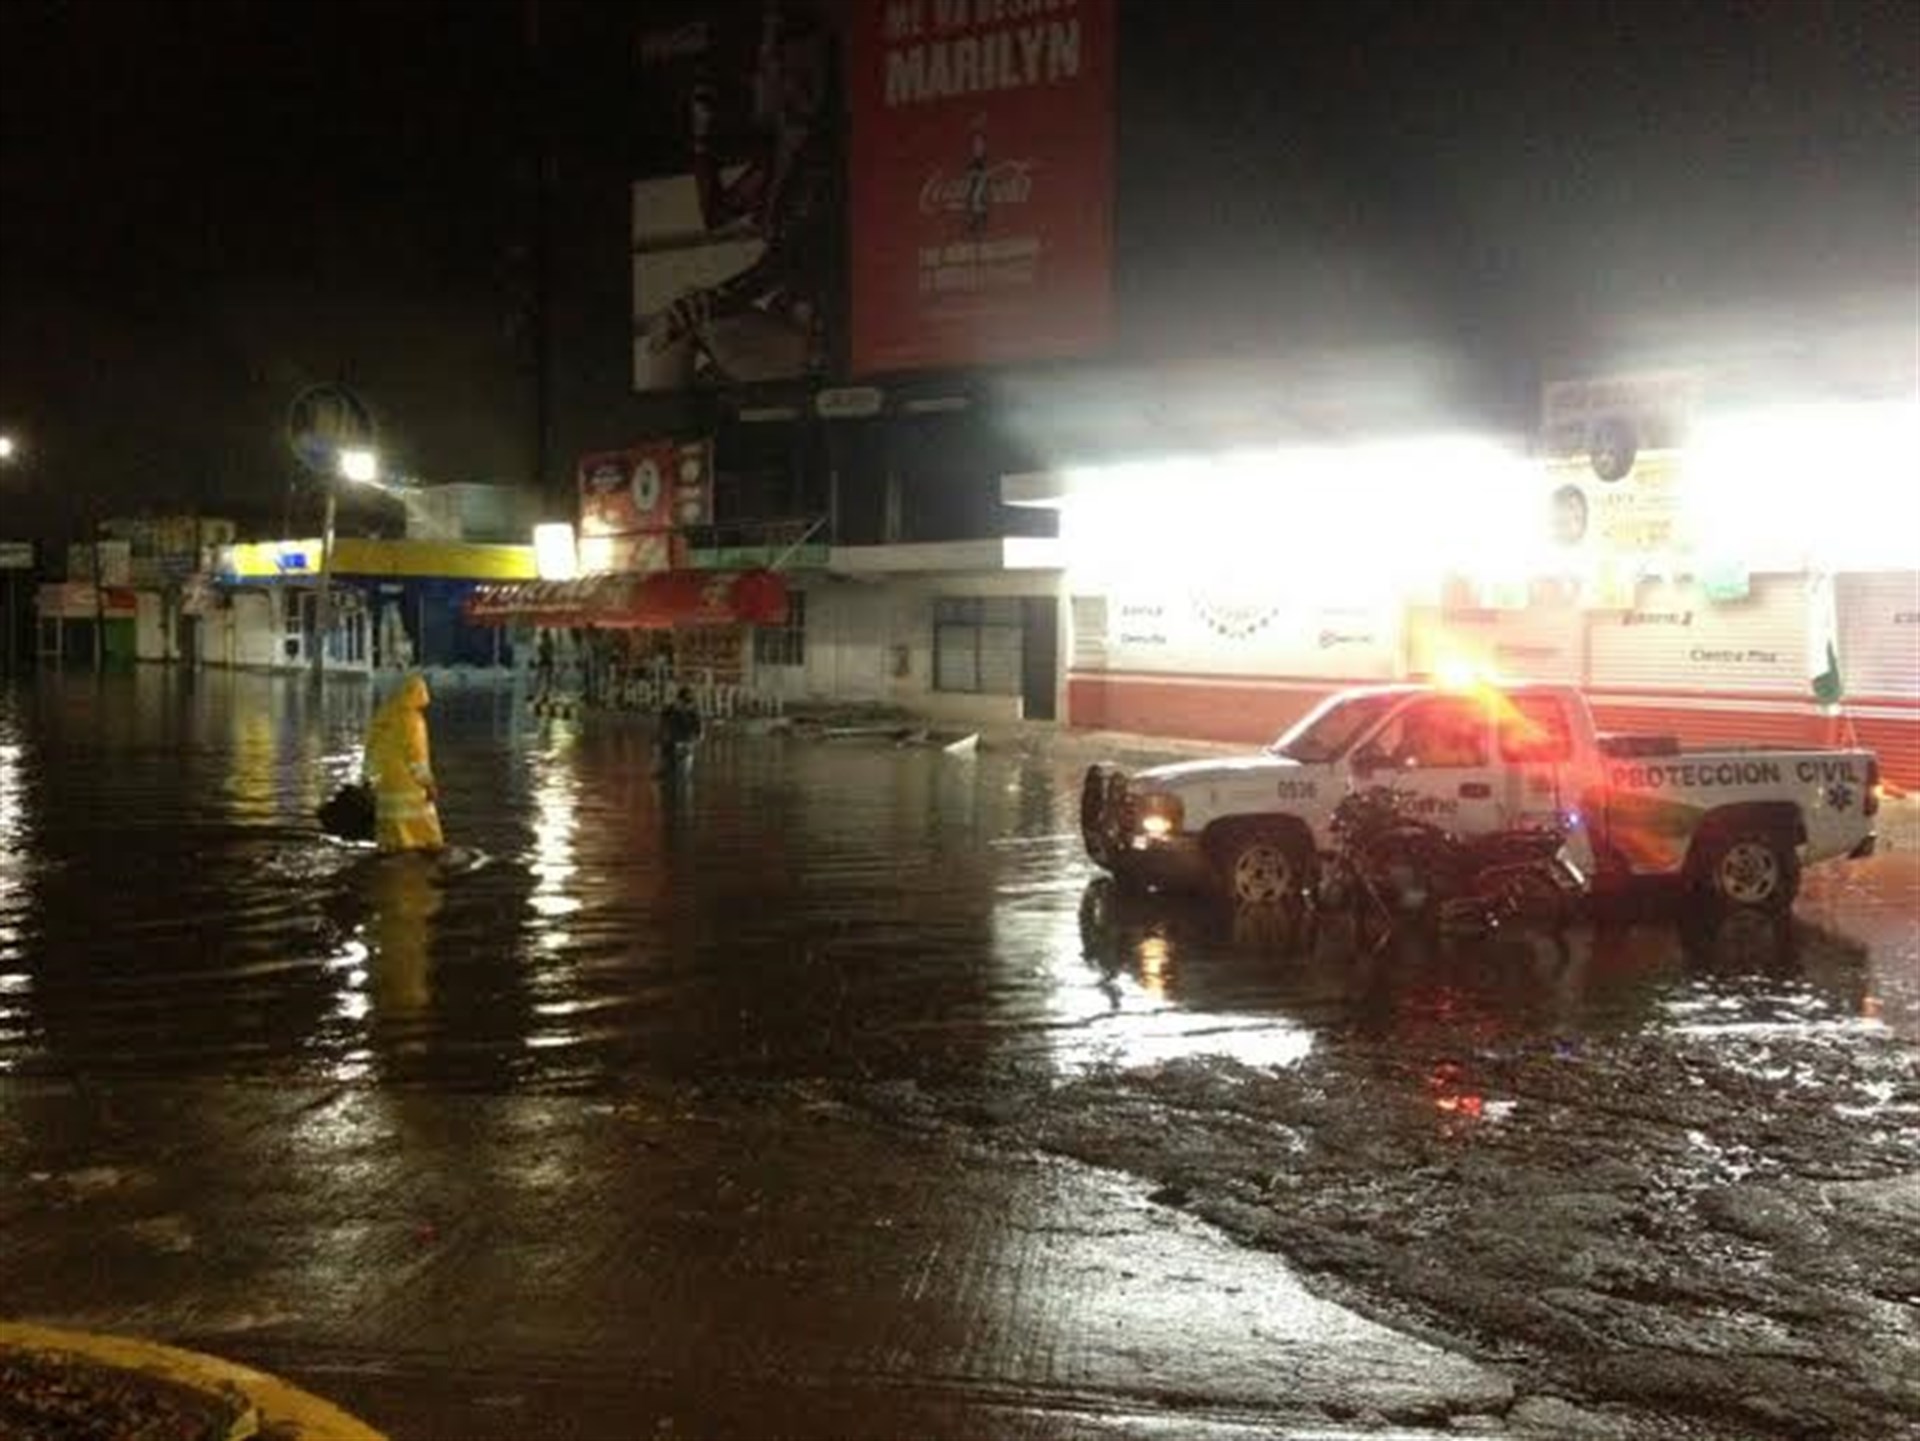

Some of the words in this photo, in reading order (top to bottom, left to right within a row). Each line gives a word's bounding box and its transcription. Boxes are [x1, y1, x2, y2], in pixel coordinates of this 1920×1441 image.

[884, 17, 1080, 108] MARILYN
[1611, 761, 1780, 789] PROTECCION
[1796, 758, 1860, 785] CIVIL
